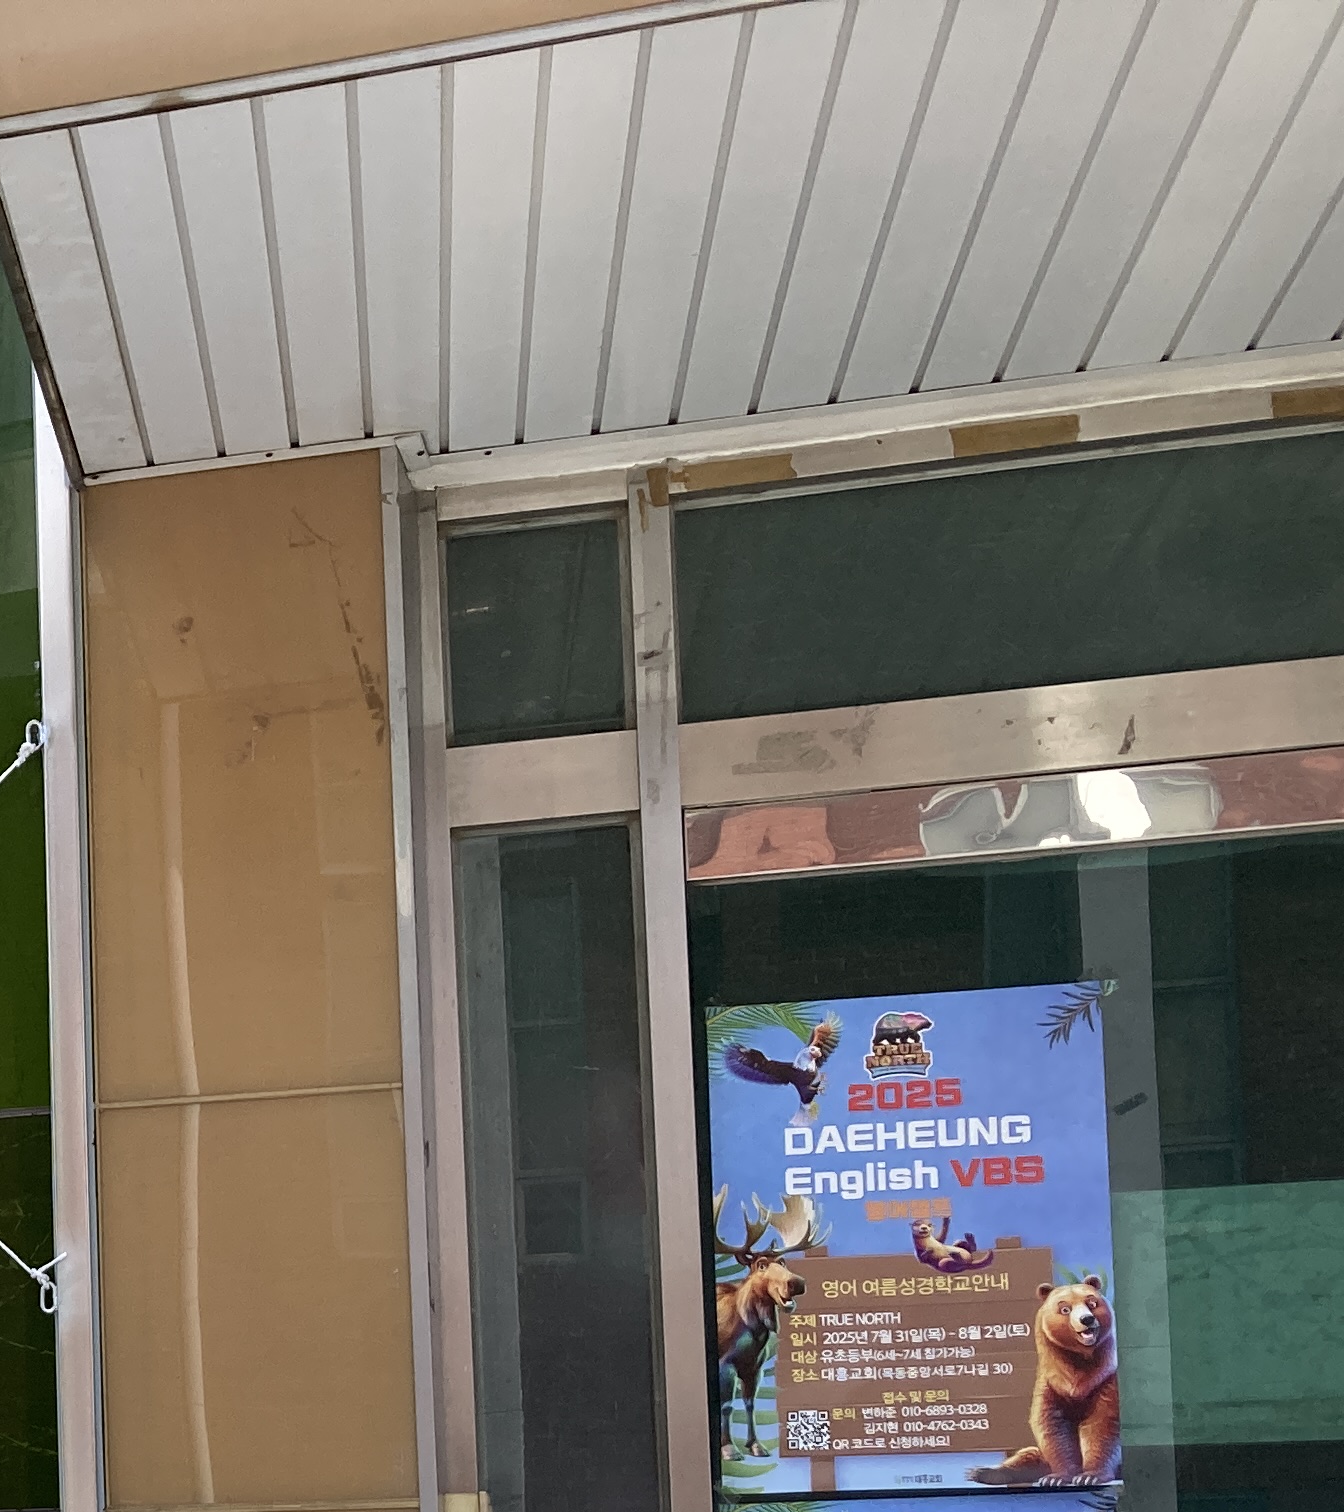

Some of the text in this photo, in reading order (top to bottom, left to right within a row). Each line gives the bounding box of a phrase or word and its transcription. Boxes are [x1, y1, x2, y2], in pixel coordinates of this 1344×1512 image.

[873, 1043, 922, 1055] TRUE
[866, 1053, 930, 1067] NORTH
[847, 1078, 963, 1113] 2025
[784, 1114, 1031, 1156] DAEHEUNG
[784, 1155, 1045, 1200] English VBS
[822, 1273, 1009, 1298] 영어 여름성경학교안내
[789, 1312, 901, 1328] 주제 TRUE NORTH
[790, 1332, 817, 1346] 일시
[823, 1331, 868, 1345] 2025년
[871, 1329, 893, 1344] 7월
[895, 1327, 946, 1342] 31일(목)
[958, 1326, 981, 1340] 8월
[984, 1323, 1031, 1339] 2일(토)
[791, 1350, 817, 1364] 대상
[792, 1368, 819, 1382] 장소
[992, 1363, 1013, 1375] 30)
[832, 1408, 856, 1420] 문의
[901, 1404, 987, 1416] 010-6893-0328
[903, 1419, 989, 1433] 010-4762-0343
[832, 1439, 849, 1450] QR
